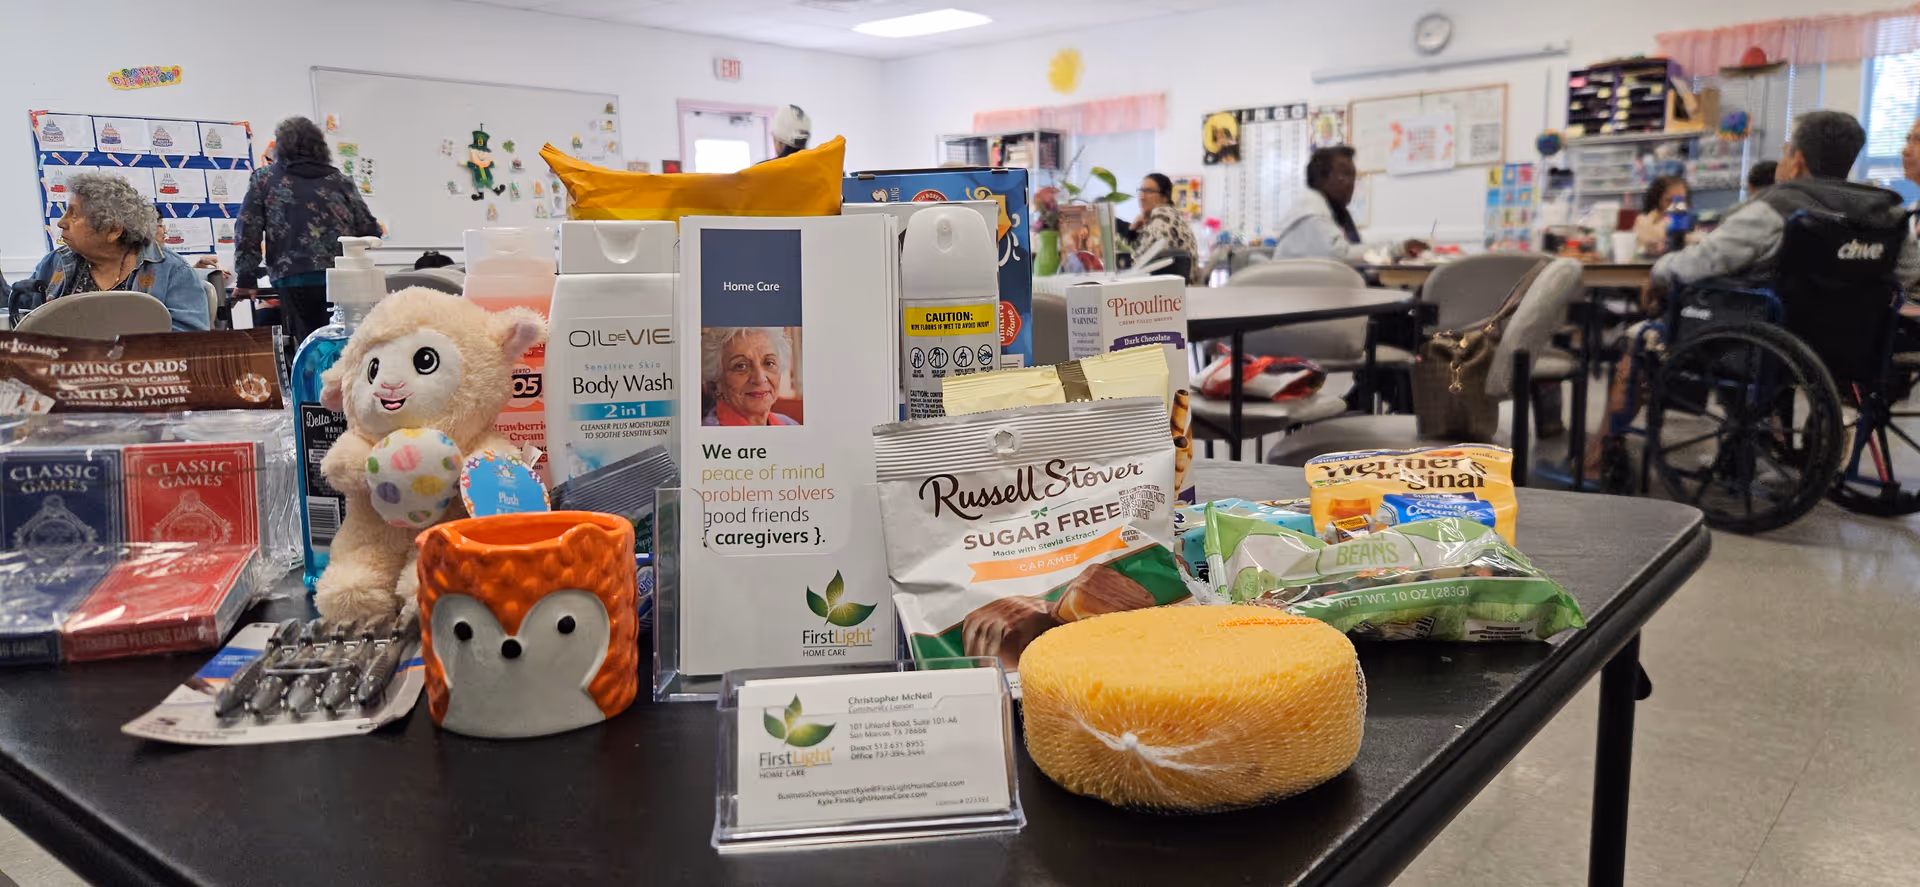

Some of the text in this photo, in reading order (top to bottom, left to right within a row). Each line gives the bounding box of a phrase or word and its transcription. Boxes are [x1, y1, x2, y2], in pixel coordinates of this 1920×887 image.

[121, 65, 160, 78] HAPPY
[1235, 102, 1305, 123] INGO
[1837, 238, 1884, 260] drive
[723, 282, 780, 291] Home Care
[1107, 295, 1181, 317] Pirouline
[926, 311, 973, 322] CAUTION:
[1006, 310, 1016, 336] Home
[569, 328, 671, 348] OIL DE VIE
[1124, 333, 1170, 346] Dark Chocolate
[18, 342, 60, 359] GAMES
[50, 360, 187, 376] PLAYING CARDS
[585, 363, 633, 371] Sensitive
[138, 385, 192, 398] JOUER
[573, 372, 673, 399] Body Wash
[604, 403, 647, 418] 2 in 1
[306, 411, 331, 427] Delta
[580, 420, 671, 431] CLEANSER PLUS MOISTURIZER
[510, 432, 544, 441] Cream
[595, 431, 621, 439] SOOTHE
[622, 429, 652, 438] SENSITIVE
[653, 428, 668, 436] SKIN
[702, 443, 767, 459] We are
[147, 459, 232, 476] CLASSIC
[1317, 455, 1347, 464] Sugar
[10, 463, 99, 481] CLASSIC
[702, 463, 825, 484] peace of mind
[20, 480, 89, 495] GAMES
[158, 474, 222, 489] GAMES
[702, 485, 835, 502] problem solvers
[919, 459, 1143, 521] Russell Stover
[1416, 500, 1468, 513] Chewy
[704, 507, 809, 528] good friends
[964, 501, 1121, 550] SUGAR FREE
[715, 530, 809, 548] caregivers
[1017, 545, 1036, 554] with
[1038, 537, 1064, 551] Stevia
[1018, 552, 1080, 571] CARAMEL
[1336, 542, 1400, 567] BEANS
[1339, 585, 1470, 610] NET WT. 10 OZ (283G)
[803, 629, 873, 648] FirstLight
[803, 649, 826, 657] HOME
[848, 692, 933, 705] Christopher McNeil
[849, 731, 863, 739] San
[850, 743, 872, 752] Direct
[760, 748, 832, 769] FirstLight
[850, 753, 873, 761] Office
[786, 769, 805, 777] CARE
